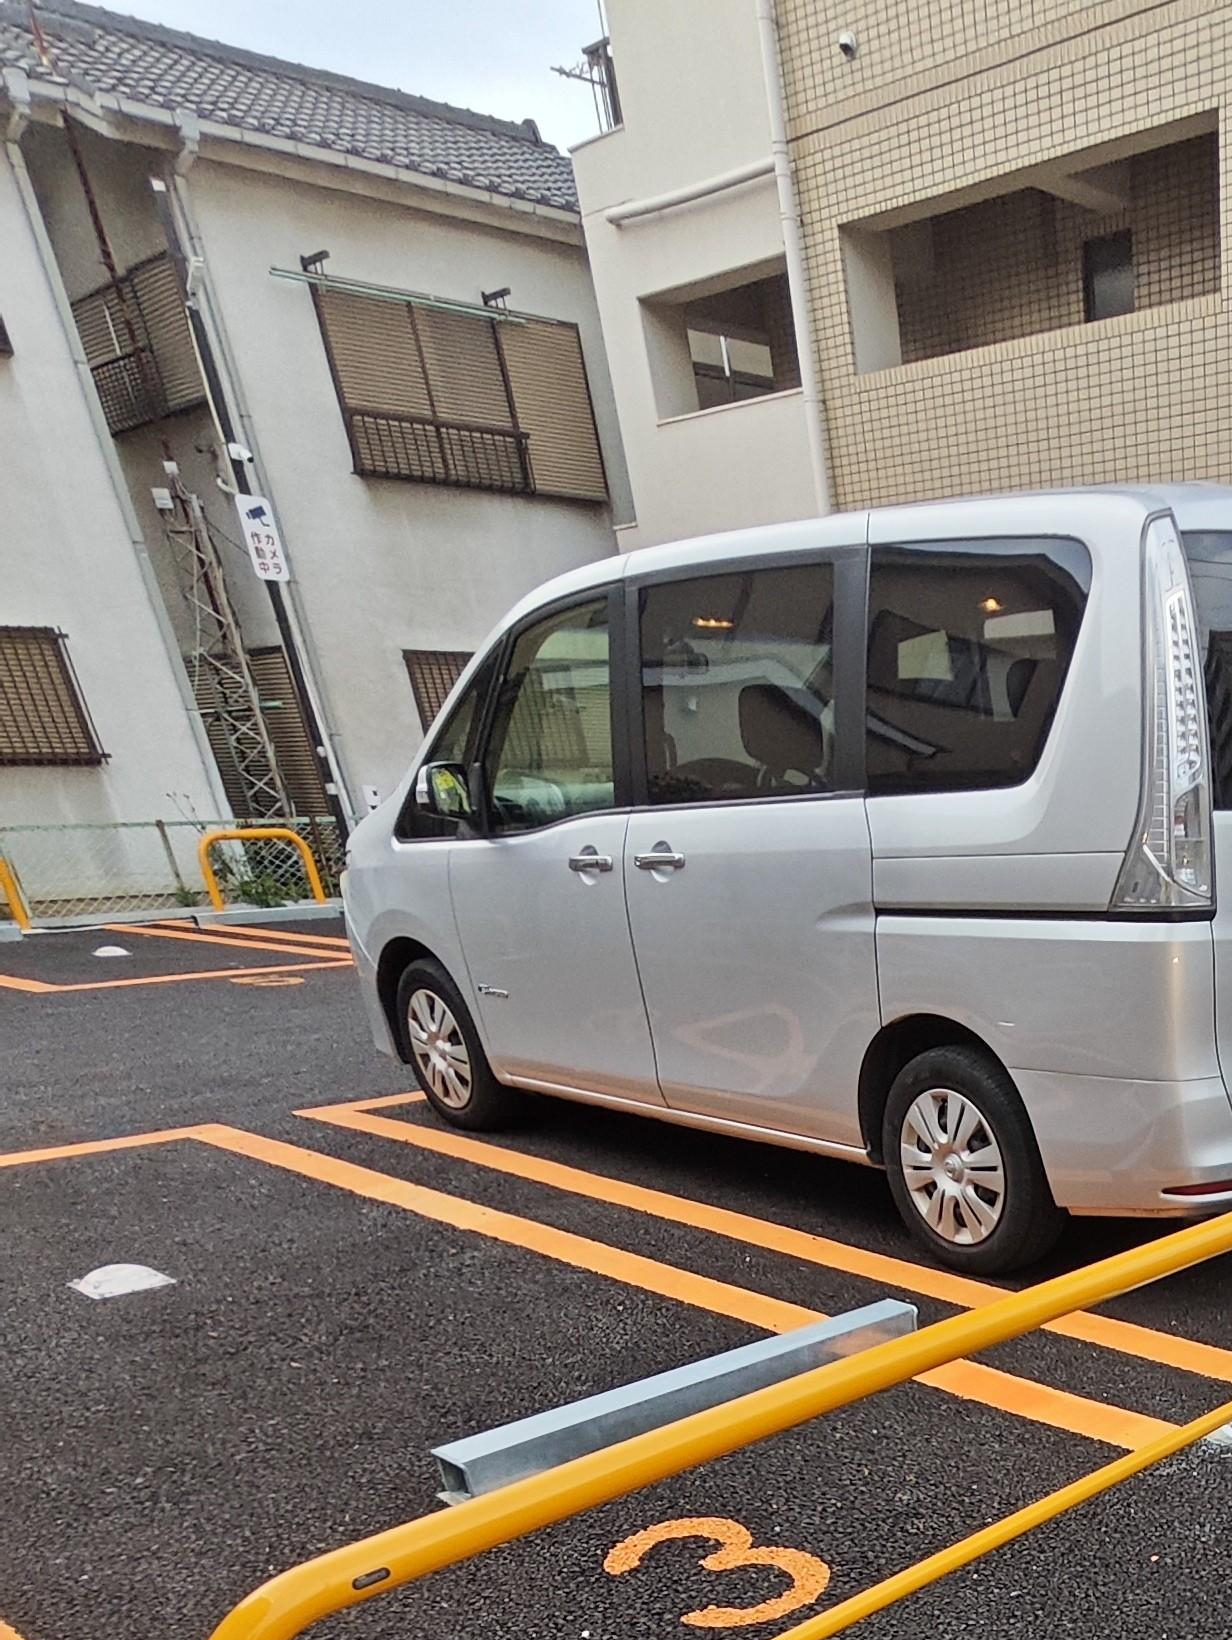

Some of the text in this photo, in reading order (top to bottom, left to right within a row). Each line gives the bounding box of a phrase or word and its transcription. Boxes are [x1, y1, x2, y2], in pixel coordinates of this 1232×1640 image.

[250, 531, 271, 574] 作動中
[264, 533, 283, 575] カメラ
[603, 1517, 831, 1628] 3
